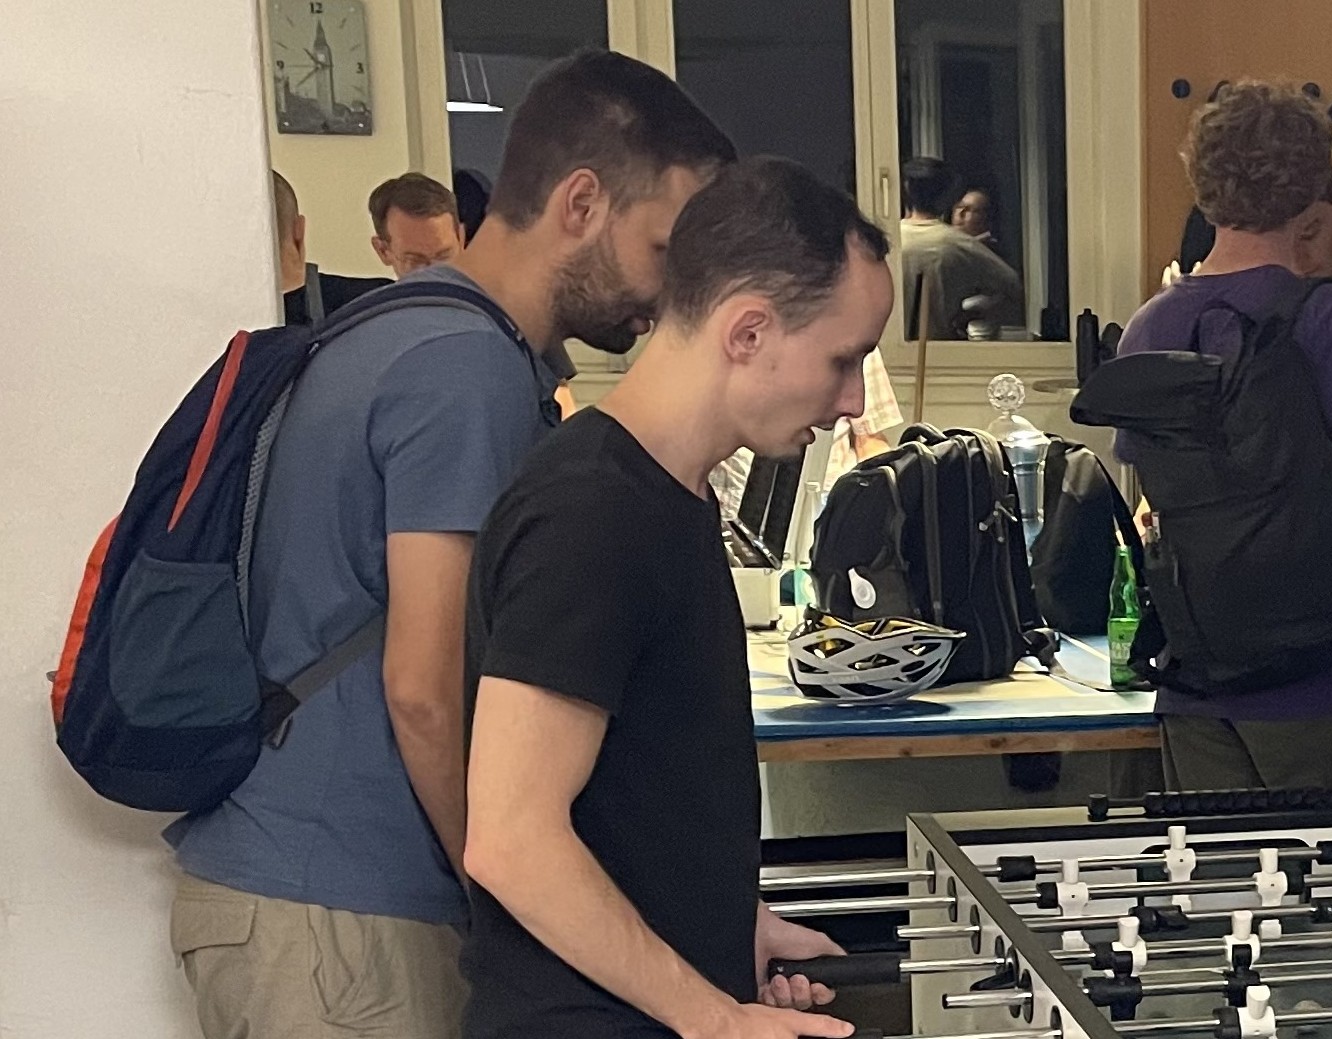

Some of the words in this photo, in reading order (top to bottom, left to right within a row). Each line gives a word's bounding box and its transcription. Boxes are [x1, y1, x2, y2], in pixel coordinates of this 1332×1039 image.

[310, 2, 323, 14] 12
[276, 60, 285, 70] 9
[356, 62, 364, 74] 3
